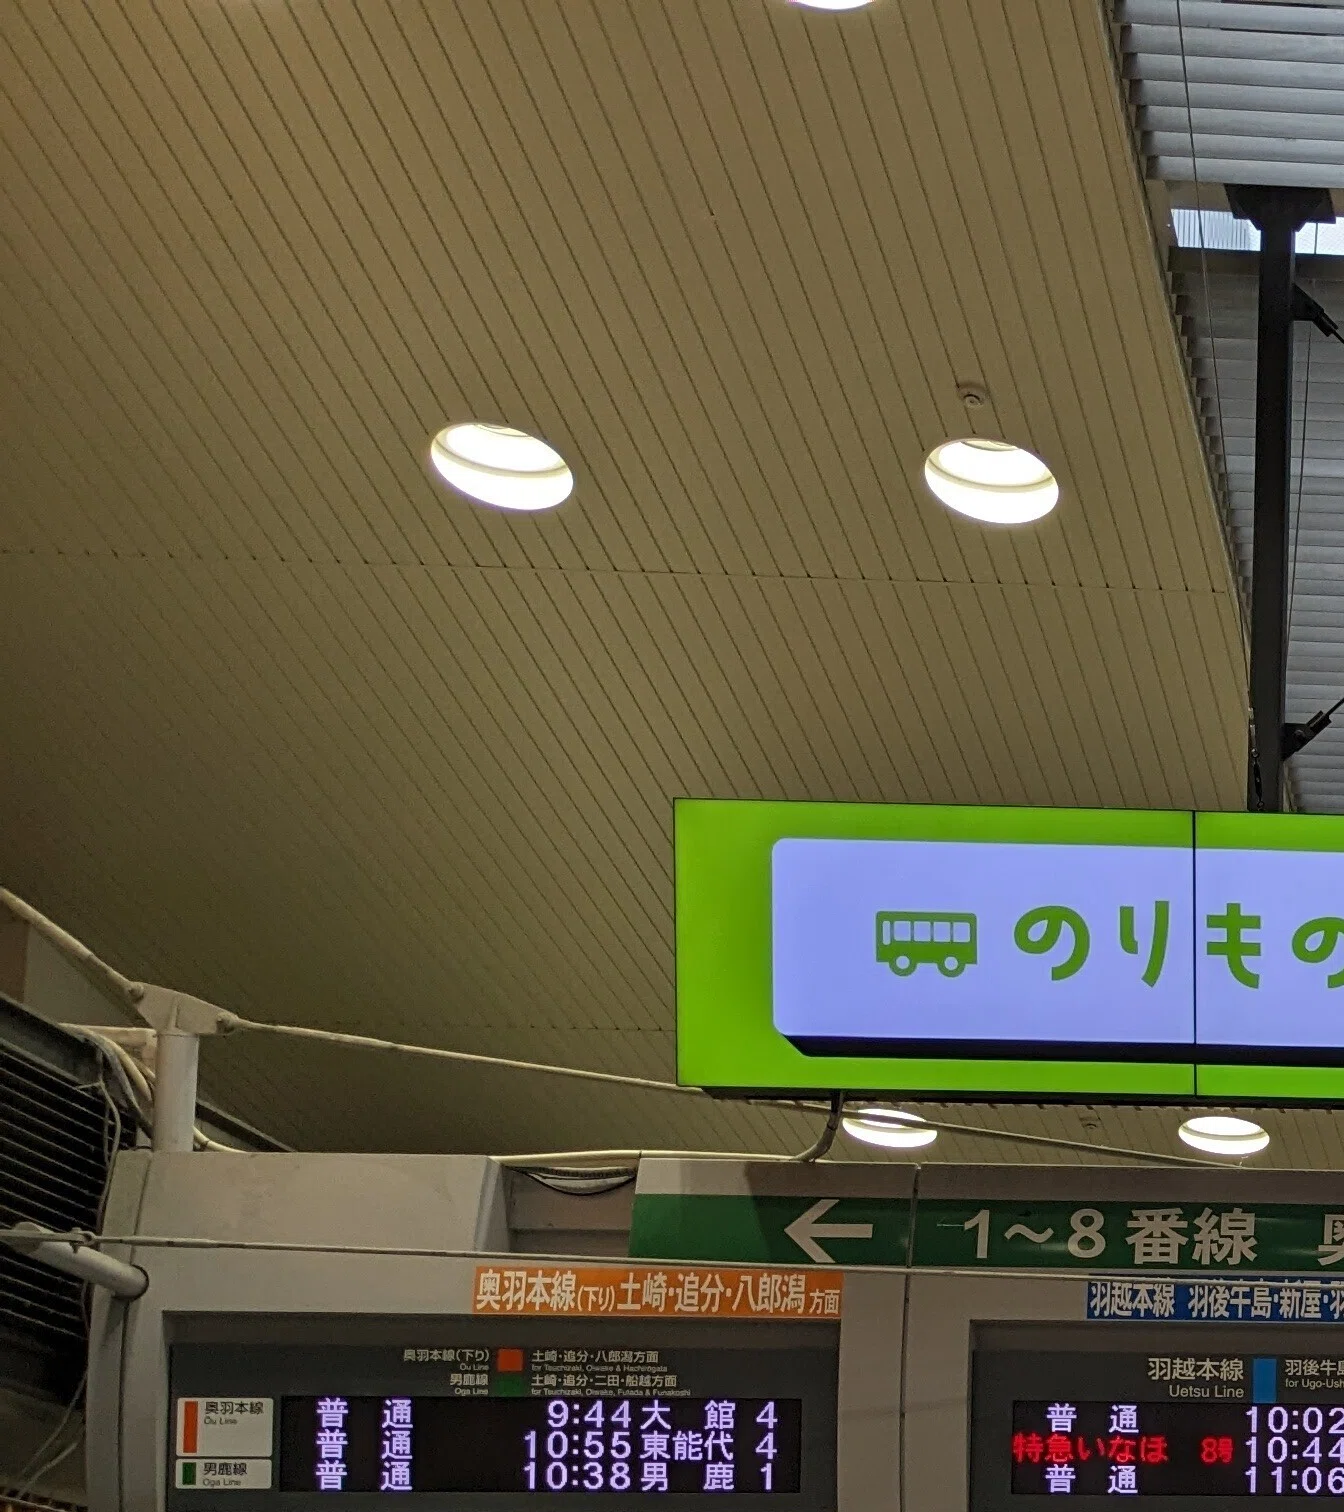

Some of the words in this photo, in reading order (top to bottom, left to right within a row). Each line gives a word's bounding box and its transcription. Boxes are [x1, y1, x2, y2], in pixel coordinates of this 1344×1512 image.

[1147, 1358, 1244, 1382] 羽越本線
[1168, 1385, 1211, 1399] Uetsu
[1214, 1385, 1244, 1399] Line
[205, 1401, 264, 1415] 奥羽本線
[546, 1400, 632, 1429] 9:44
[523, 1430, 632, 1460] 10:55
[203, 1462, 248, 1476] 男鹿線
[523, 1461, 632, 1491] 10:38
